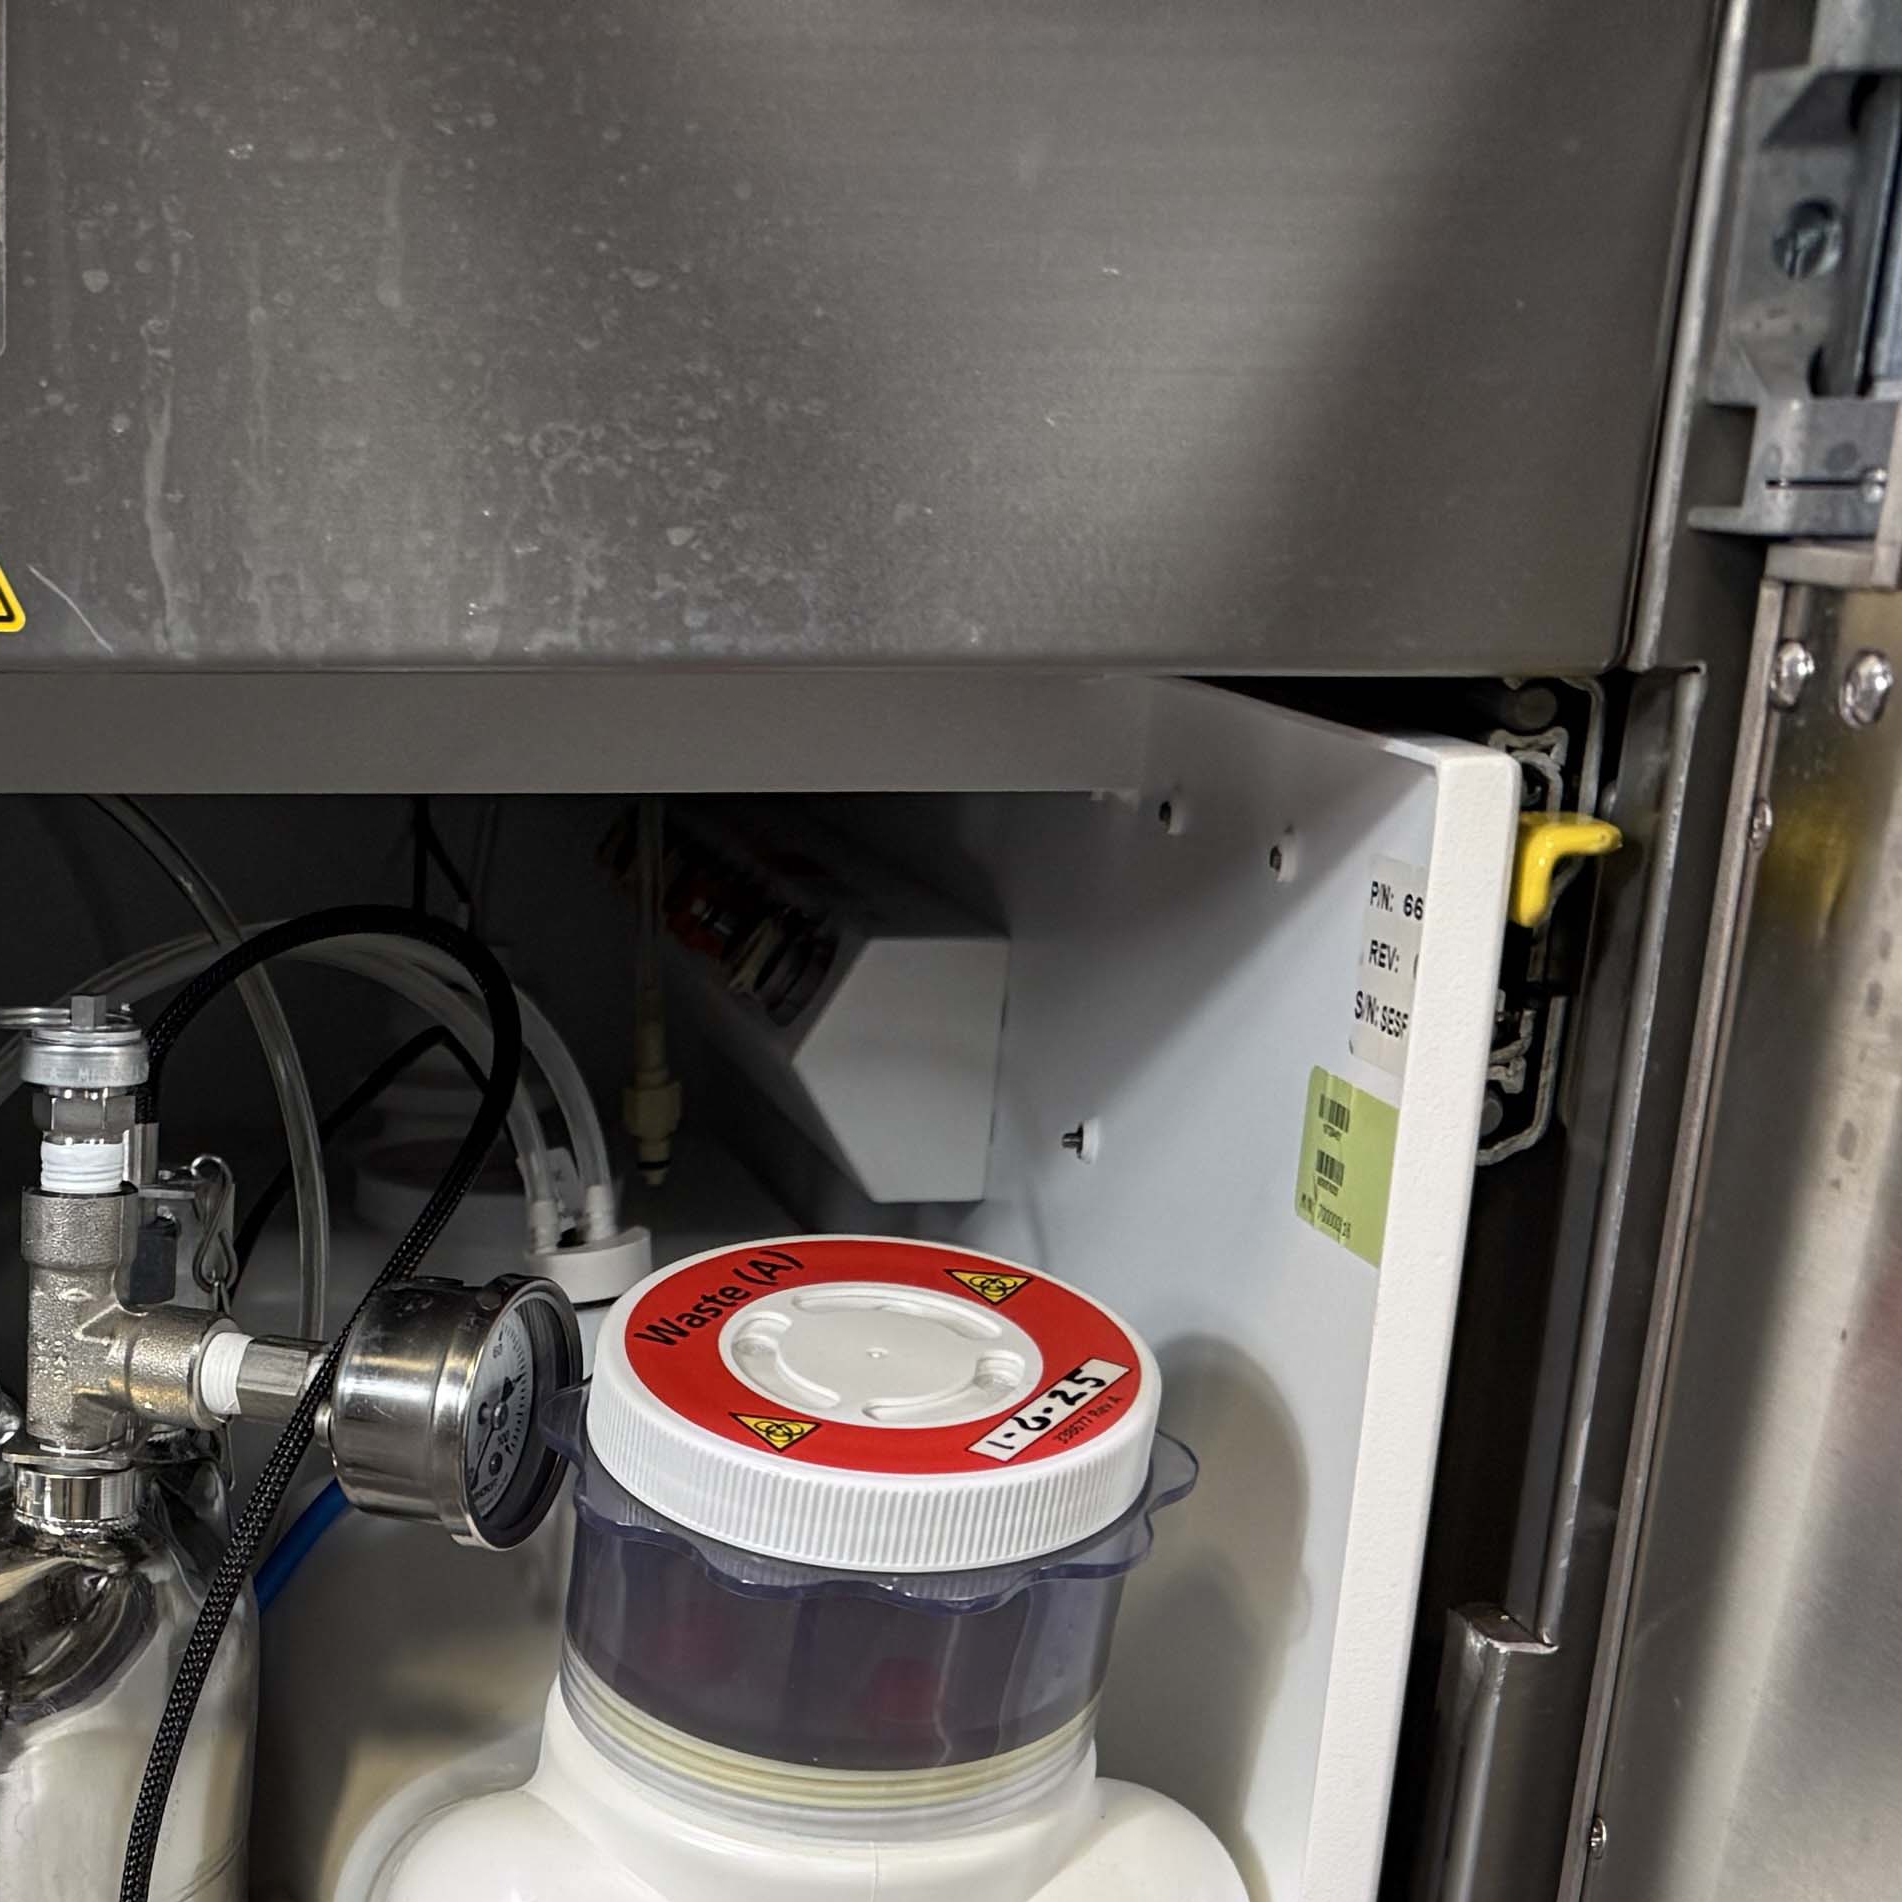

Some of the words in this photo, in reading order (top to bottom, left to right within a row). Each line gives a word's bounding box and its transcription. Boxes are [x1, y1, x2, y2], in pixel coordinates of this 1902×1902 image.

[1370, 880, 1393, 913] P/N:
[1368, 939, 1400, 974] REV:
[1354, 990, 1381, 1026] S/N:
[634, 1285, 752, 1346] Waste
[732, 1250, 804, 1285] (A)
